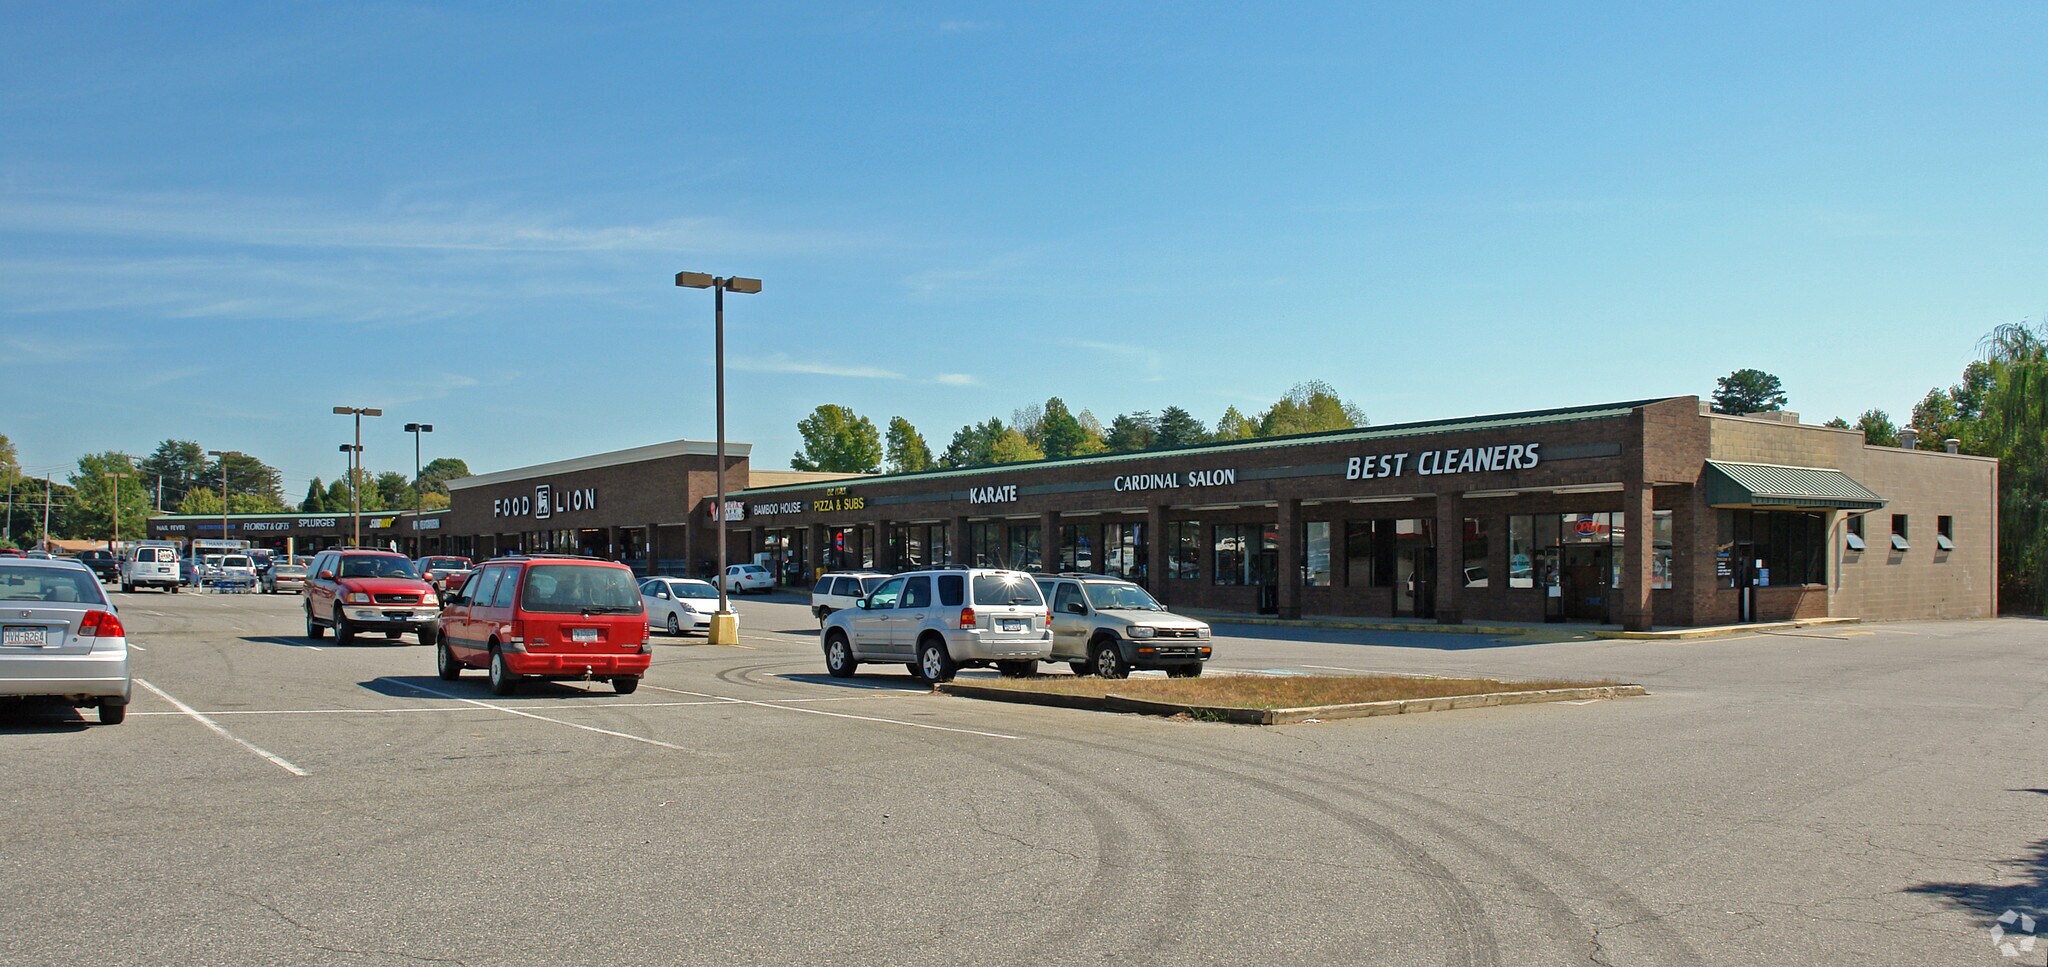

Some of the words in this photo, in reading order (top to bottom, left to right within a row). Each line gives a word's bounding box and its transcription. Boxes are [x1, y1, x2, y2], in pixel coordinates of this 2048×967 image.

[1345, 452, 1408, 480] BEST
[1417, 443, 1539, 476] CLEANERS
[1113, 472, 1179, 492] CARDINAL
[1188, 468, 1235, 488] SALON
[970, 484, 1017, 504] KARATE
[494, 496, 530, 518] FOOD
[556, 488, 595, 512] LION
[753, 503, 779, 516] BAMBOO
[780, 501, 802, 514] HOUSE
[813, 500, 834, 512] PIZZA
[836, 499, 841, 511] &
[843, 497, 864, 510] SUBS
[243, 522, 270, 531] FLORIST
[270, 522, 275, 531] &
[275, 522, 290, 531] GIFTS
[298, 518, 336, 528] SPLURGES
